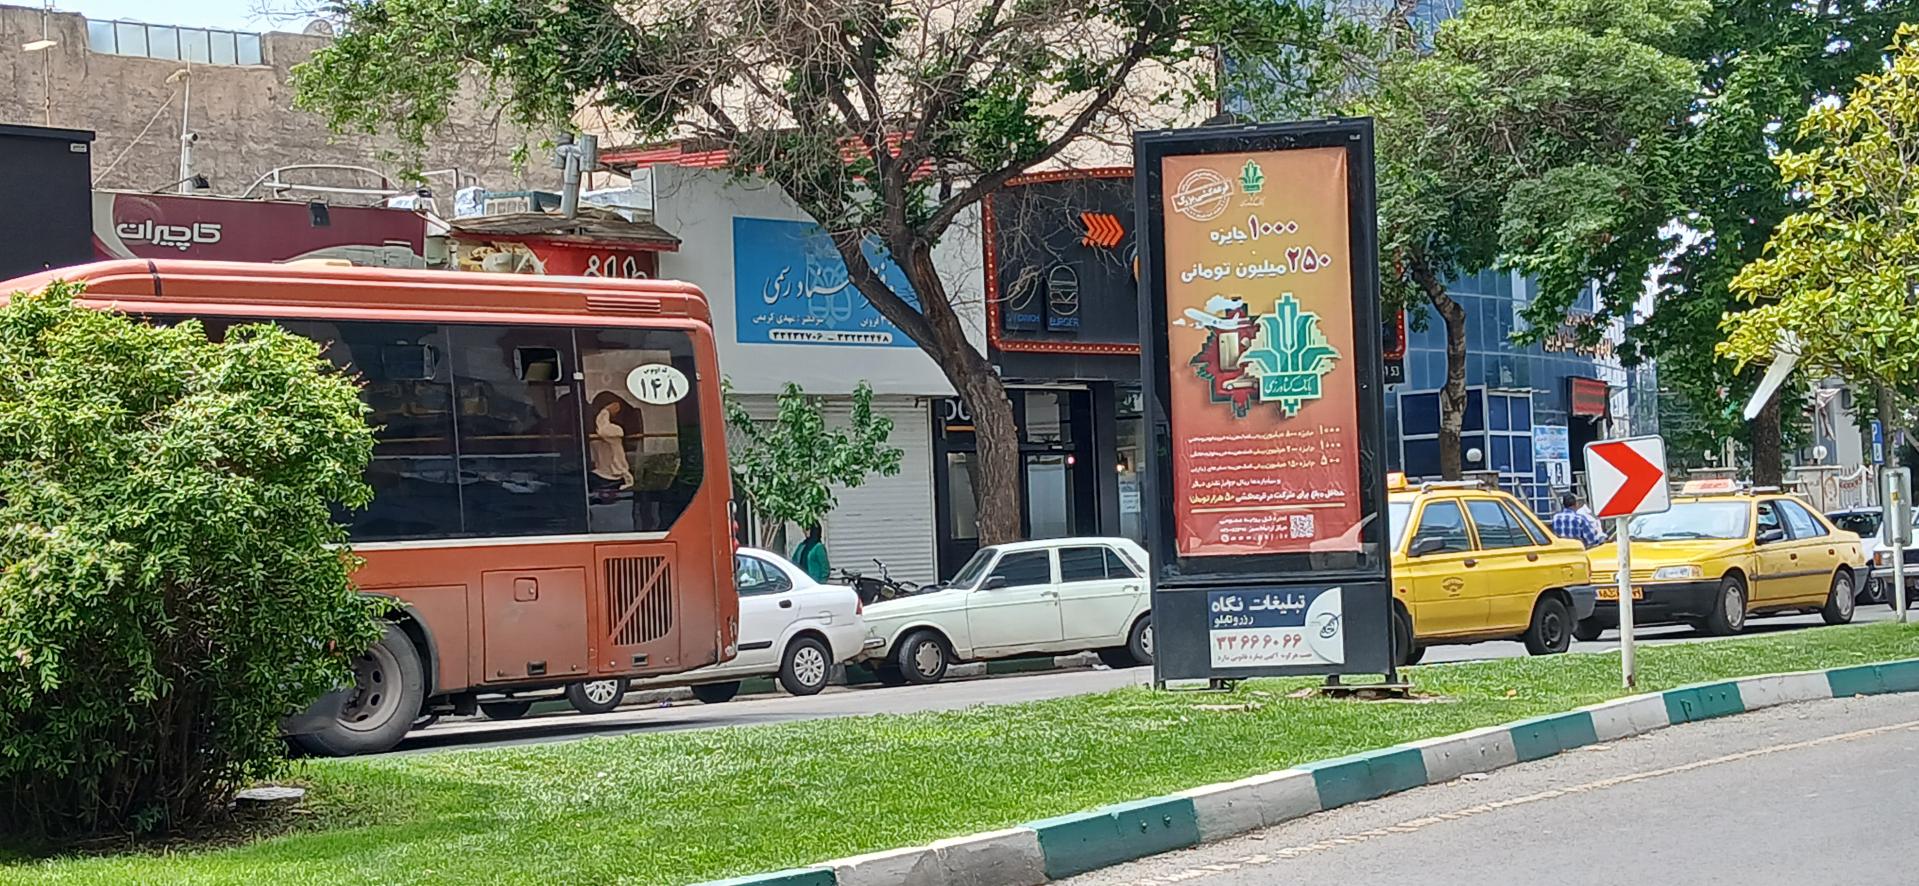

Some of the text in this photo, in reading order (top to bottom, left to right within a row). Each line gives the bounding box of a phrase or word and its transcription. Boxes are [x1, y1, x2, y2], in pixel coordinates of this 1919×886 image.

[116, 220, 222, 250] کاچیران
[1210, 214, 1299, 245] ۱۰۰۰ جایزه
[1181, 246, 1331, 282] ۲۵۰ میلیون تومانی
[763, 265, 792, 304] رسمی
[640, 377, 678, 404] ۱۴۸
[1319, 424, 1340, 435] ۱۰۰۰
[1320, 438, 1341, 450] ۱۰۰۰
[1320, 454, 1340, 466] ۵۰۰
[1211, 593, 1306, 615] تبلیغات نگاه
